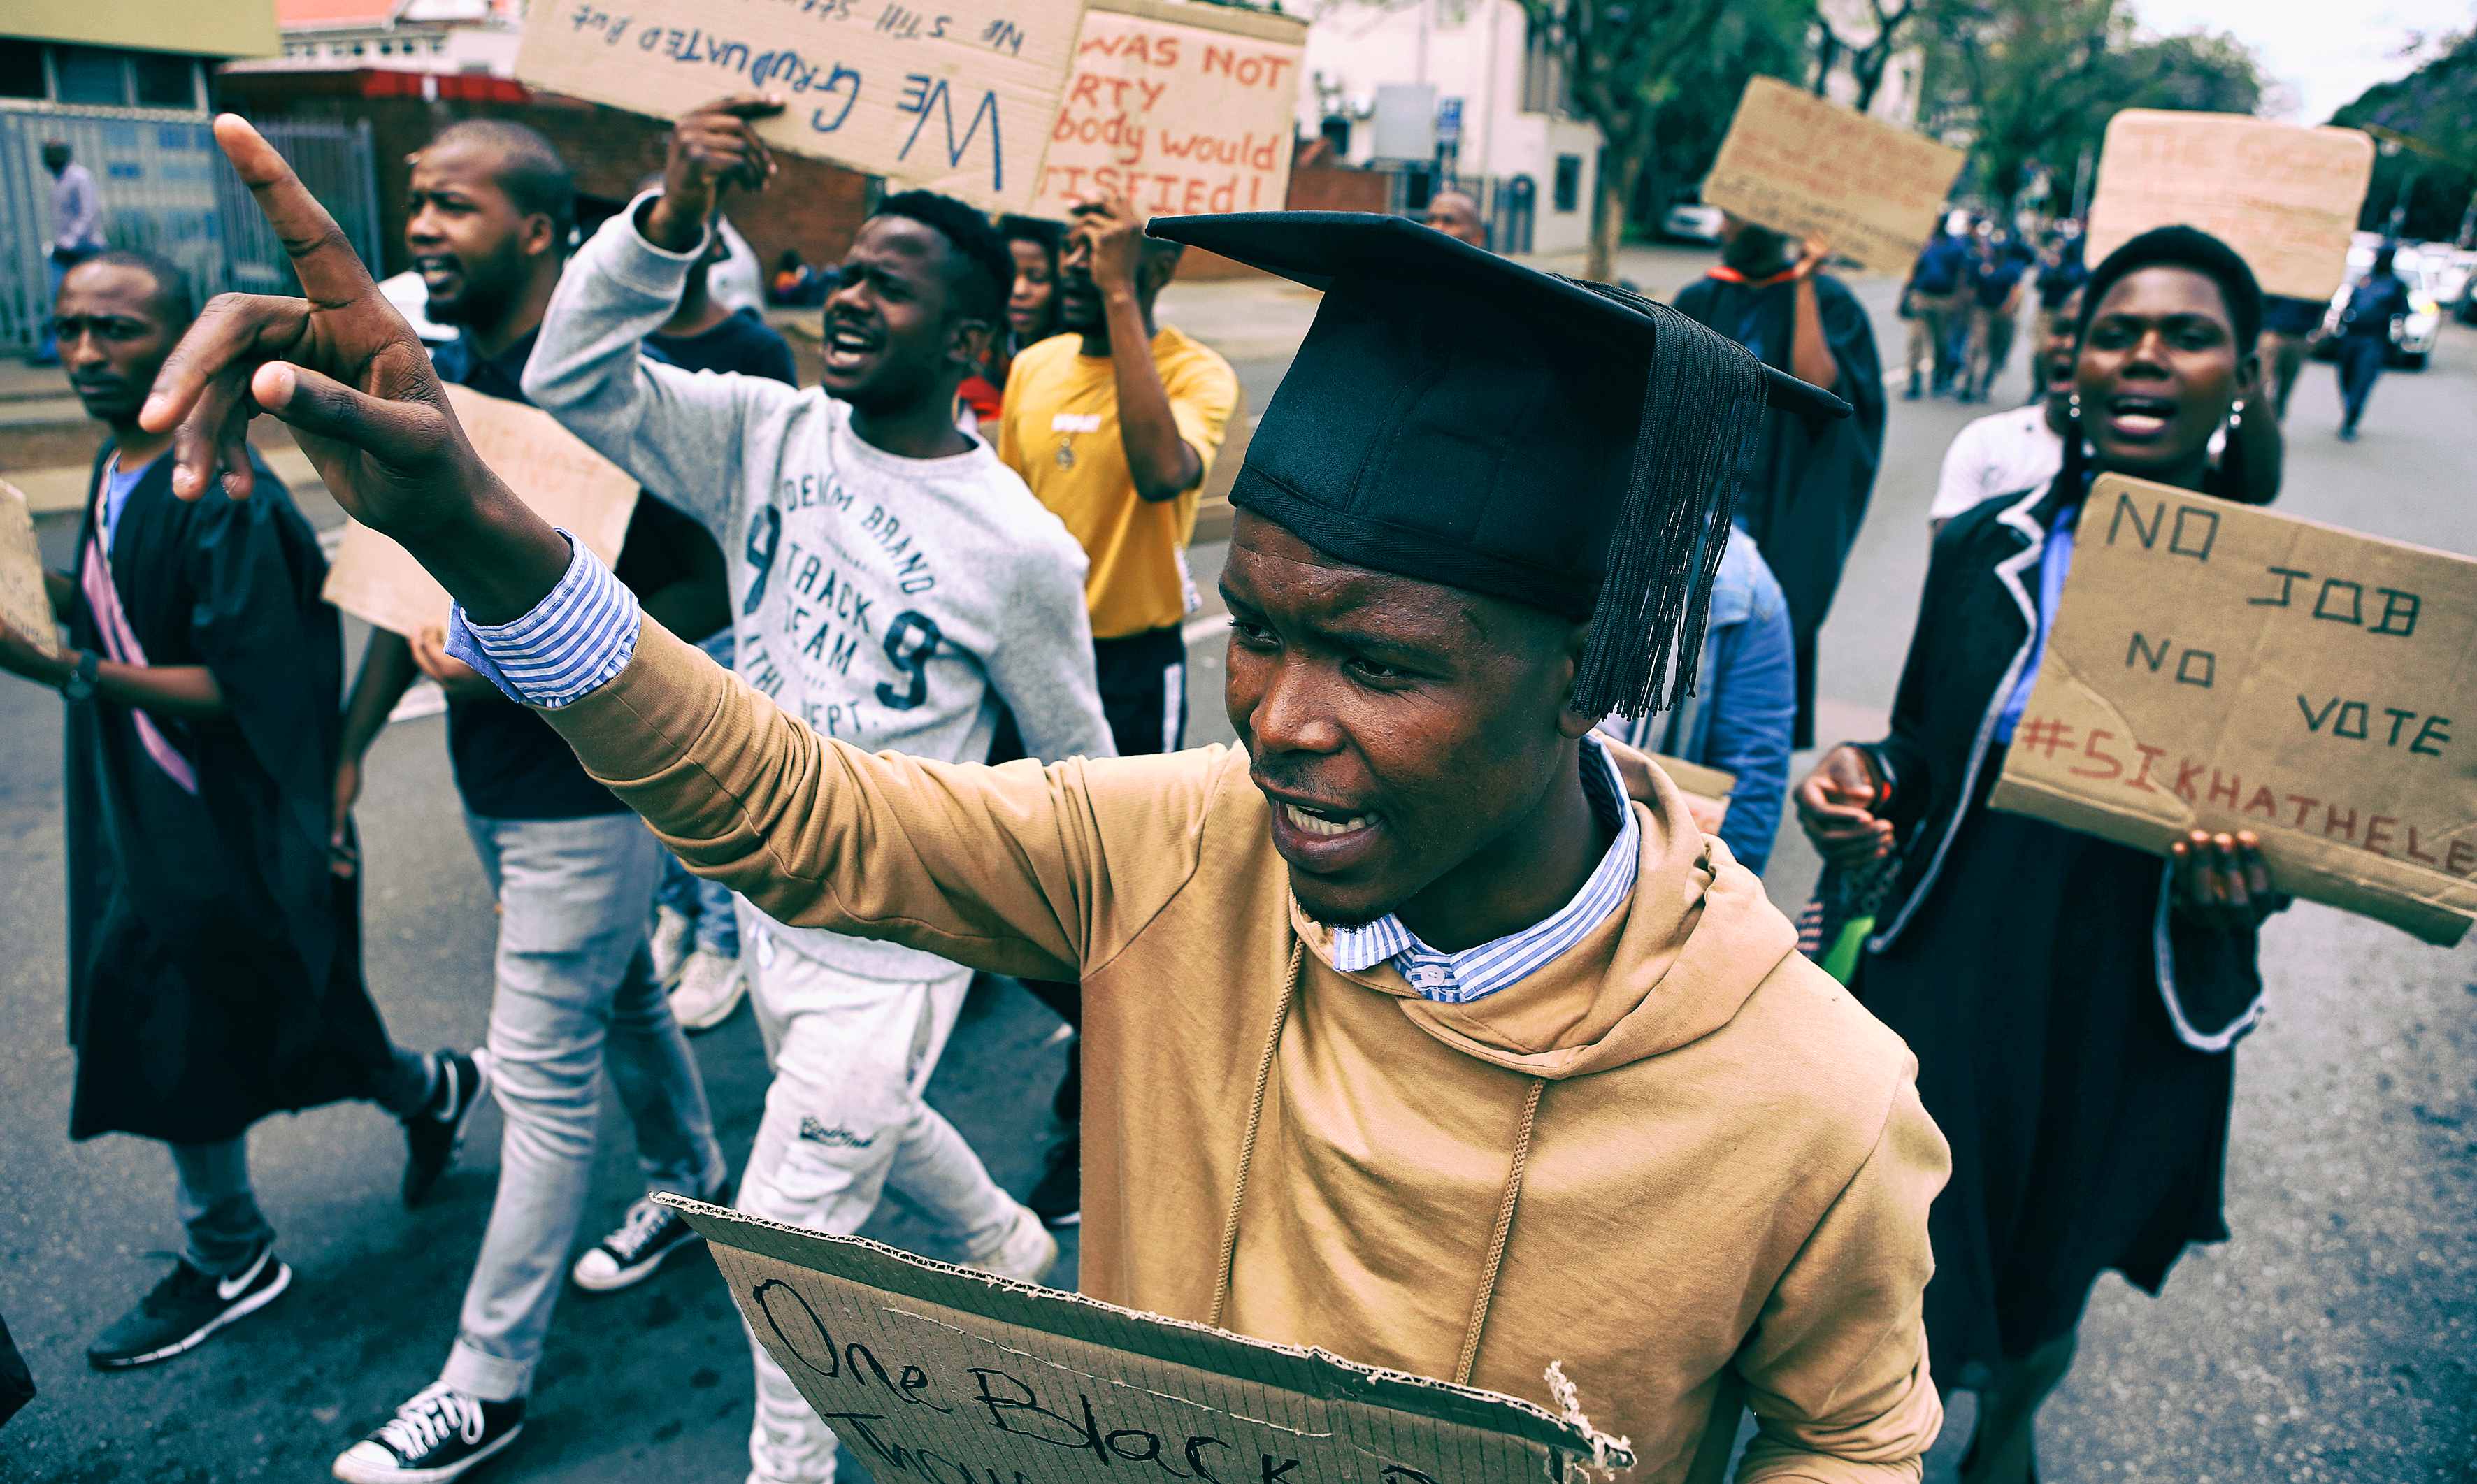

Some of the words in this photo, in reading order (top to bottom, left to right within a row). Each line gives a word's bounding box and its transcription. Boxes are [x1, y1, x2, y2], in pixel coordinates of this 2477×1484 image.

[1202, 45, 1293, 90] NOT
[1160, 129, 1281, 173] would
[742, 503, 782, 617] 9
[861, 503, 935, 595] BRAND
[2106, 491, 2220, 561] NO
[784, 541, 873, 635] TRACK
[2246, 566, 2421, 638] JOB
[874, 609, 943, 712] 9
[2125, 631, 2217, 689] NO
[2297, 693, 2453, 758] VOTE
[2020, 716, 2476, 878] #SIKHATHELE
[752, 1278, 954, 1415] One
